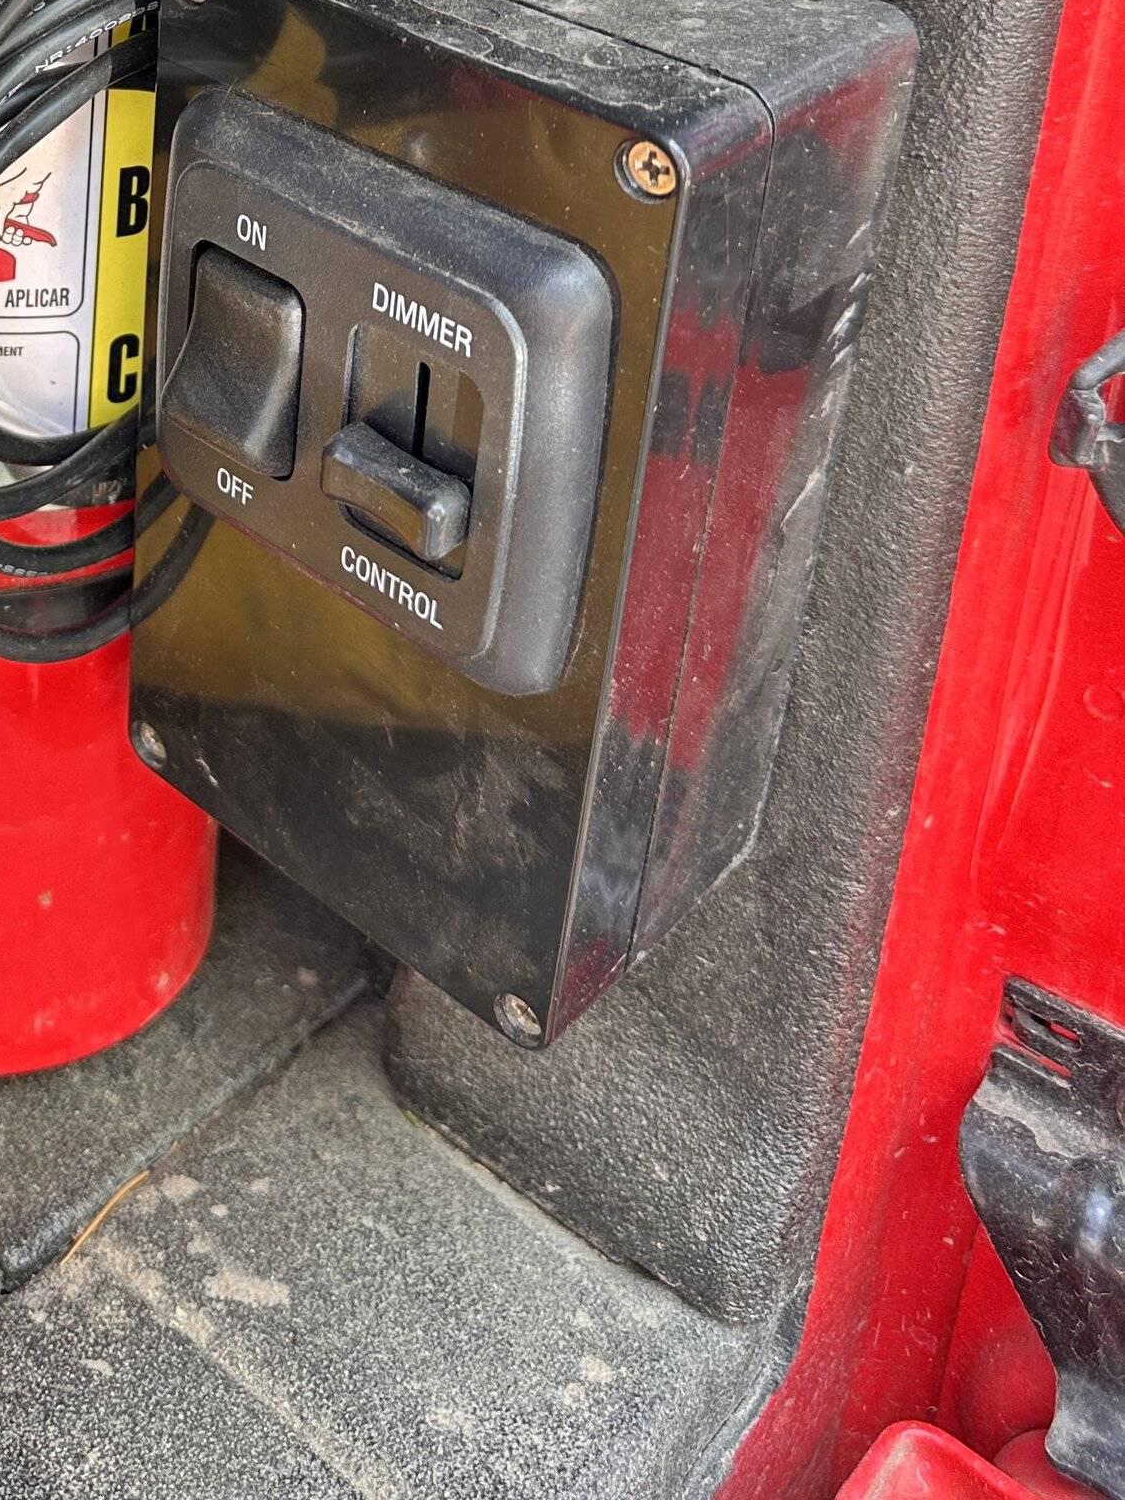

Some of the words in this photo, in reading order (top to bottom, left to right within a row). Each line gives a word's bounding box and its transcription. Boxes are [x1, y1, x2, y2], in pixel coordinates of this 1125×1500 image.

[116, 165, 151, 239] B
[235, 213, 268, 252] ON
[4, 287, 70, 308] APLICAR
[371, 282, 474, 359] DIMMER
[106, 333, 140, 405] C
[216, 466, 255, 506] OFF
[339, 544, 445, 632] CONTROL
